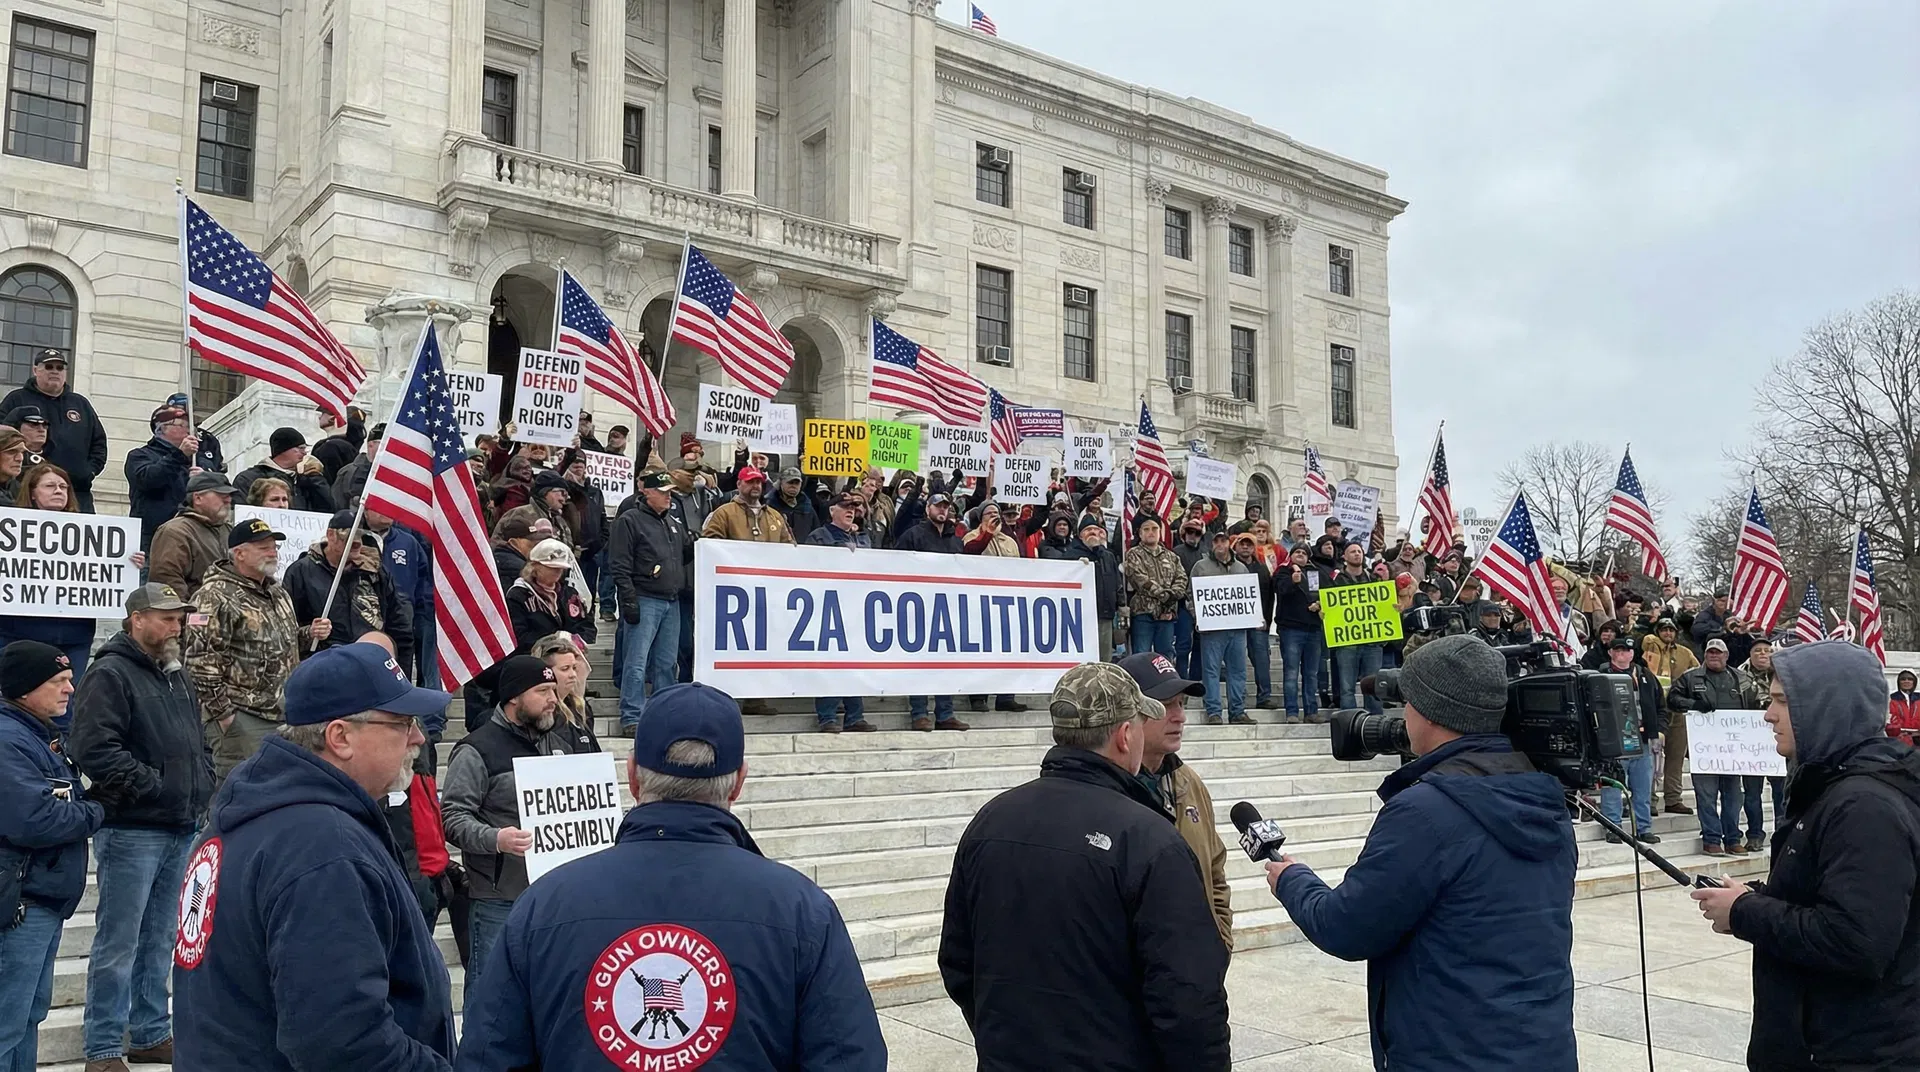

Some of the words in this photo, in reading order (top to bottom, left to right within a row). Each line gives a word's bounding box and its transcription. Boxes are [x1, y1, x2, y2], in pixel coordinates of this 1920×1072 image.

[1174, 155, 1217, 181] STATE
[1225, 170, 1270, 197] HOUSE
[524, 353, 580, 375] DEFEND
[445, 373, 485, 392] FEND
[522, 372, 578, 393] DEFEND
[452, 392, 470, 408] UR
[533, 391, 564, 410] OUR
[709, 391, 761, 412] SECOND
[457, 410, 485, 427] HTS
[518, 408, 573, 430] RIGHTS
[705, 408, 763, 427] AMENDMENT
[704, 421, 713, 433] IS
[715, 423, 729, 435] MY
[731, 426, 764, 440] PERMIT
[809, 423, 866, 440] DEFEND
[823, 441, 850, 455] OUR
[879, 438, 899, 450] OUR
[949, 442, 971, 456] OUR
[1073, 436, 1103, 448] DEFEND
[872, 449, 908, 464] RIGHUT
[1080, 448, 1097, 459] OUR
[810, 456, 863, 473] RIGHTS
[1005, 458, 1041, 472] DEFEND
[1073, 460, 1103, 471] RIGHTS
[1012, 472, 1032, 484] OUR
[1004, 485, 1039, 498] RIGHTS
[0, 518, 126, 558] SECOND
[0, 557, 125, 583] AMENDMENT
[21, 584, 49, 604] MY
[56, 586, 124, 607] PERMIT
[1197, 586, 1257, 602] PEACEABLE
[1327, 586, 1390, 607] DEFEND
[1202, 602, 1256, 617] ASSEMBLY
[1344, 605, 1378, 623] OUR
[715, 585, 767, 651] RI
[787, 588, 849, 652] 2A
[864, 591, 1084, 654] COALITION
[1334, 621, 1394, 643] RIGHTS
[523, 782, 617, 817] PEACEABLE
[534, 817, 615, 854] ASSEMBLY
[595, 941, 635, 988] GUN
[638, 930, 727, 988] OWNERS
[598, 1024, 627, 1052] OF
[625, 1024, 724, 1072] AMERICA
